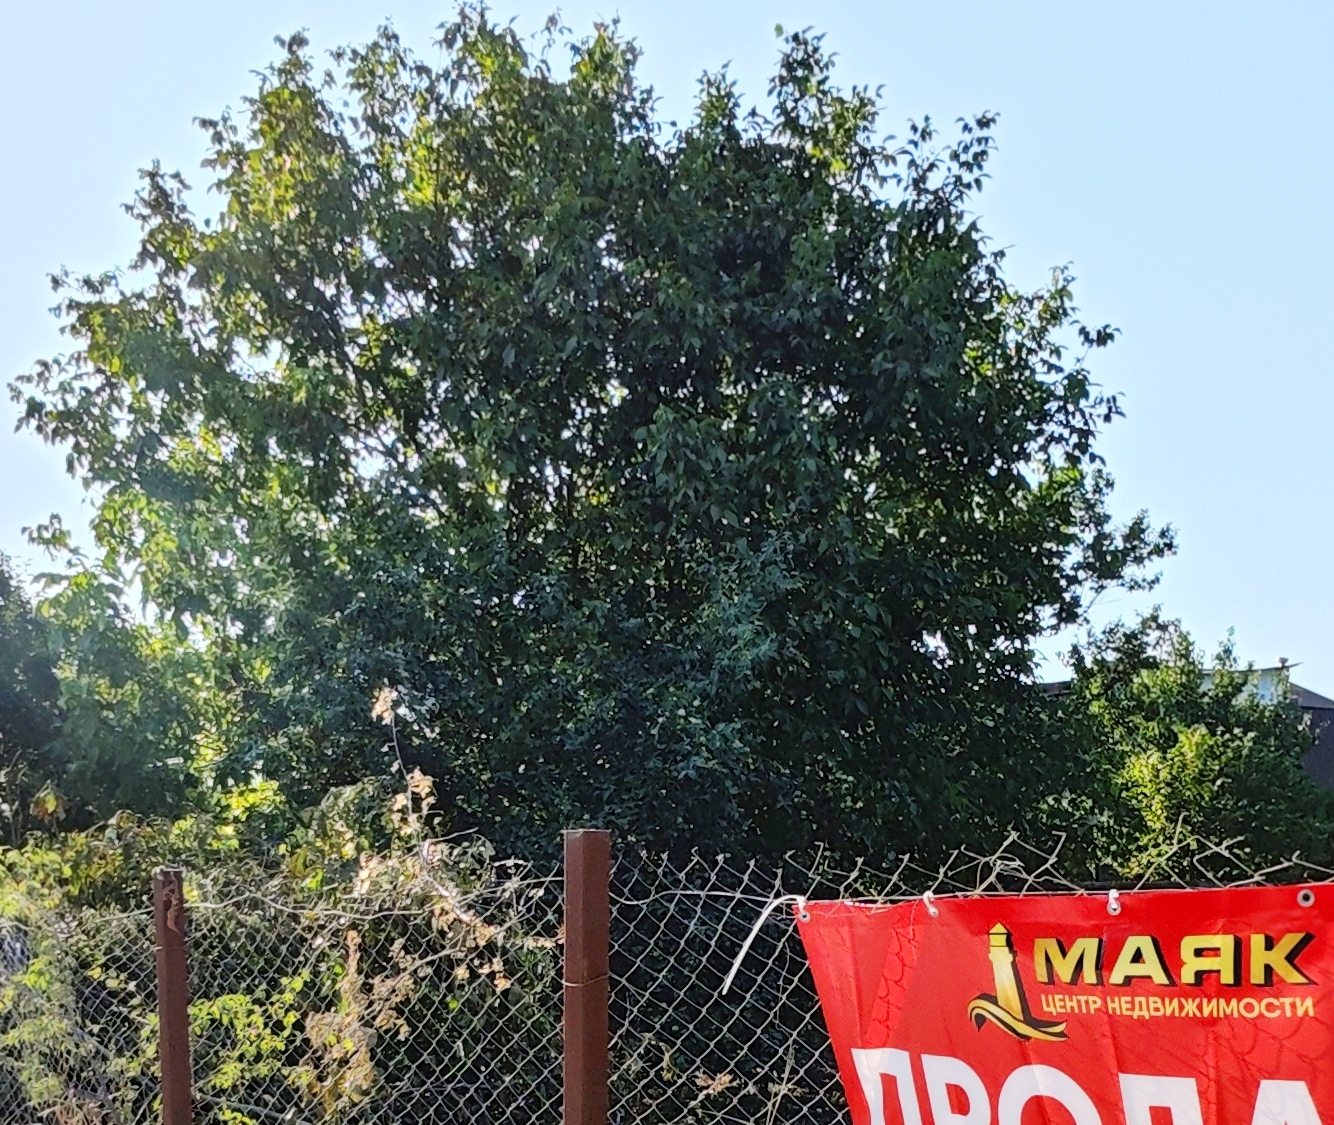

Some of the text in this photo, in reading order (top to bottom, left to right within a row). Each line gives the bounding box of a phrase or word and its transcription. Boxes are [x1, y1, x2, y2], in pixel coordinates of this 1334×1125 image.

[1034, 932, 1319, 987] МАЯК
[1041, 994, 1315, 1020] ЦЕНТР НЕДВИЖИМОСТИ
